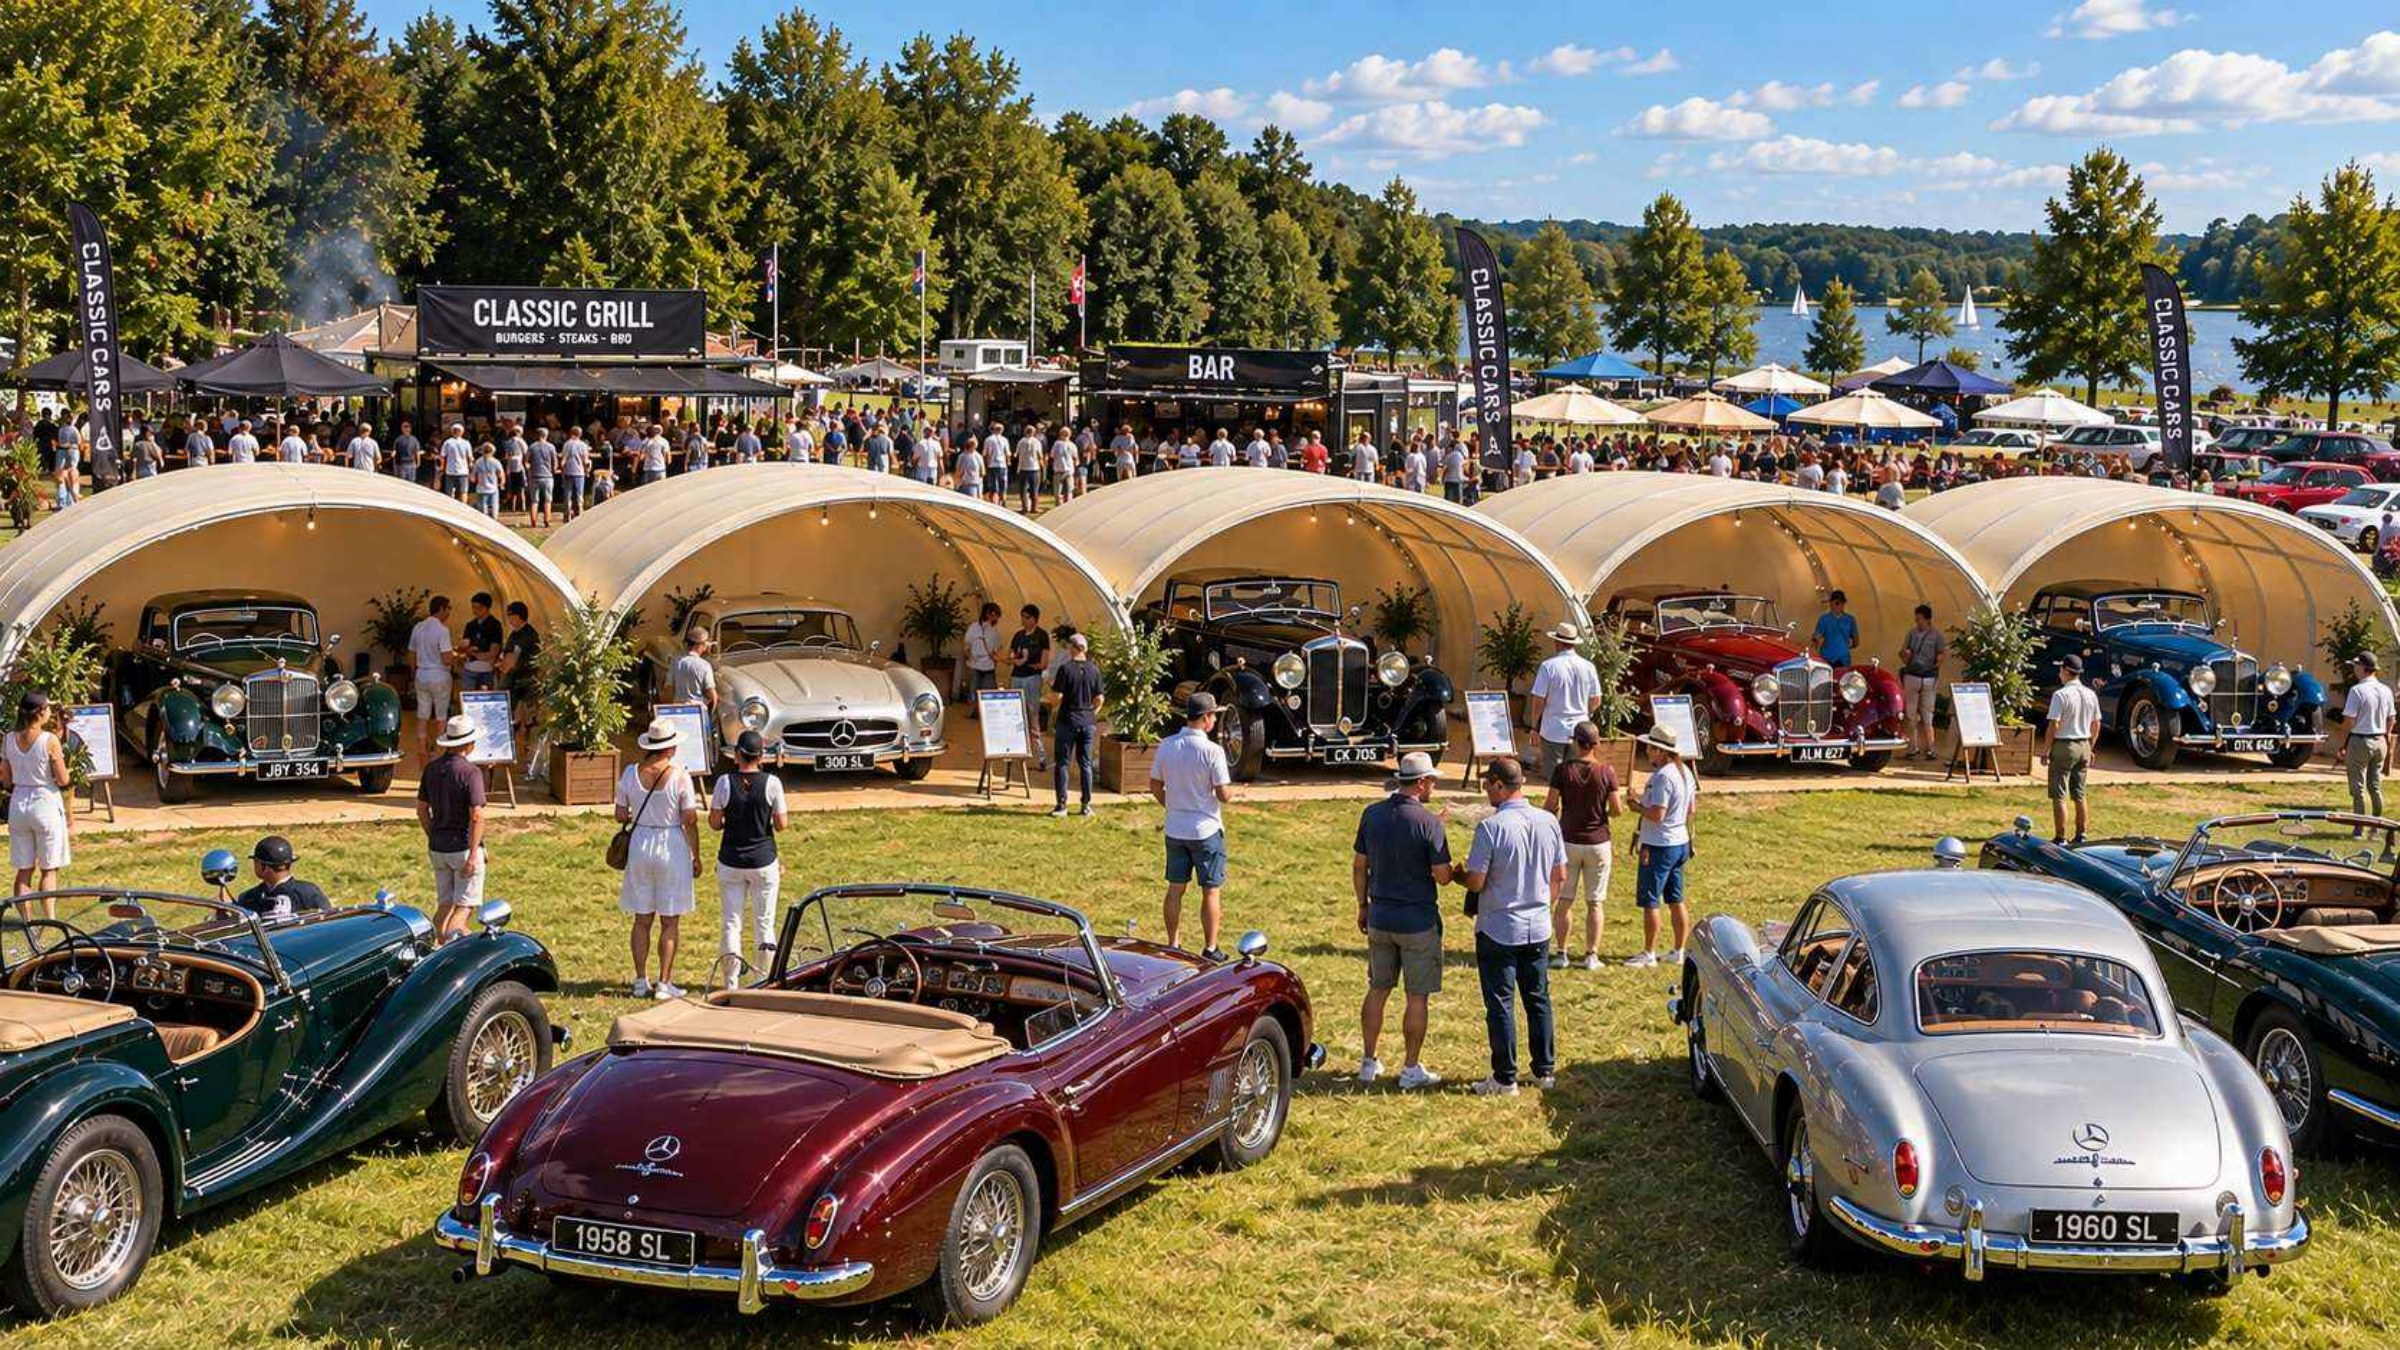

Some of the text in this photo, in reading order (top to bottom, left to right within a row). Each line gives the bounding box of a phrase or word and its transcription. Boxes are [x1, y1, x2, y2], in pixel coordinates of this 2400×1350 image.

[82, 241, 111, 412] CLASSIC CARS
[473, 298, 654, 328] CLASSIC GRILL
[558, 332, 599, 344] STEAKS
[1471, 267, 1500, 424] CLASSIC CARS
[1188, 354, 1235, 381] BAR
[2154, 297, 2183, 440] CLASSIC CARS
[825, 754, 865, 768] 300 SL
[1355, 747, 1377, 760] 705
[266, 763, 291, 778] JBY
[2054, 1214, 2158, 1241] 1960 SL
[576, 1224, 670, 1260] 1958 SL
